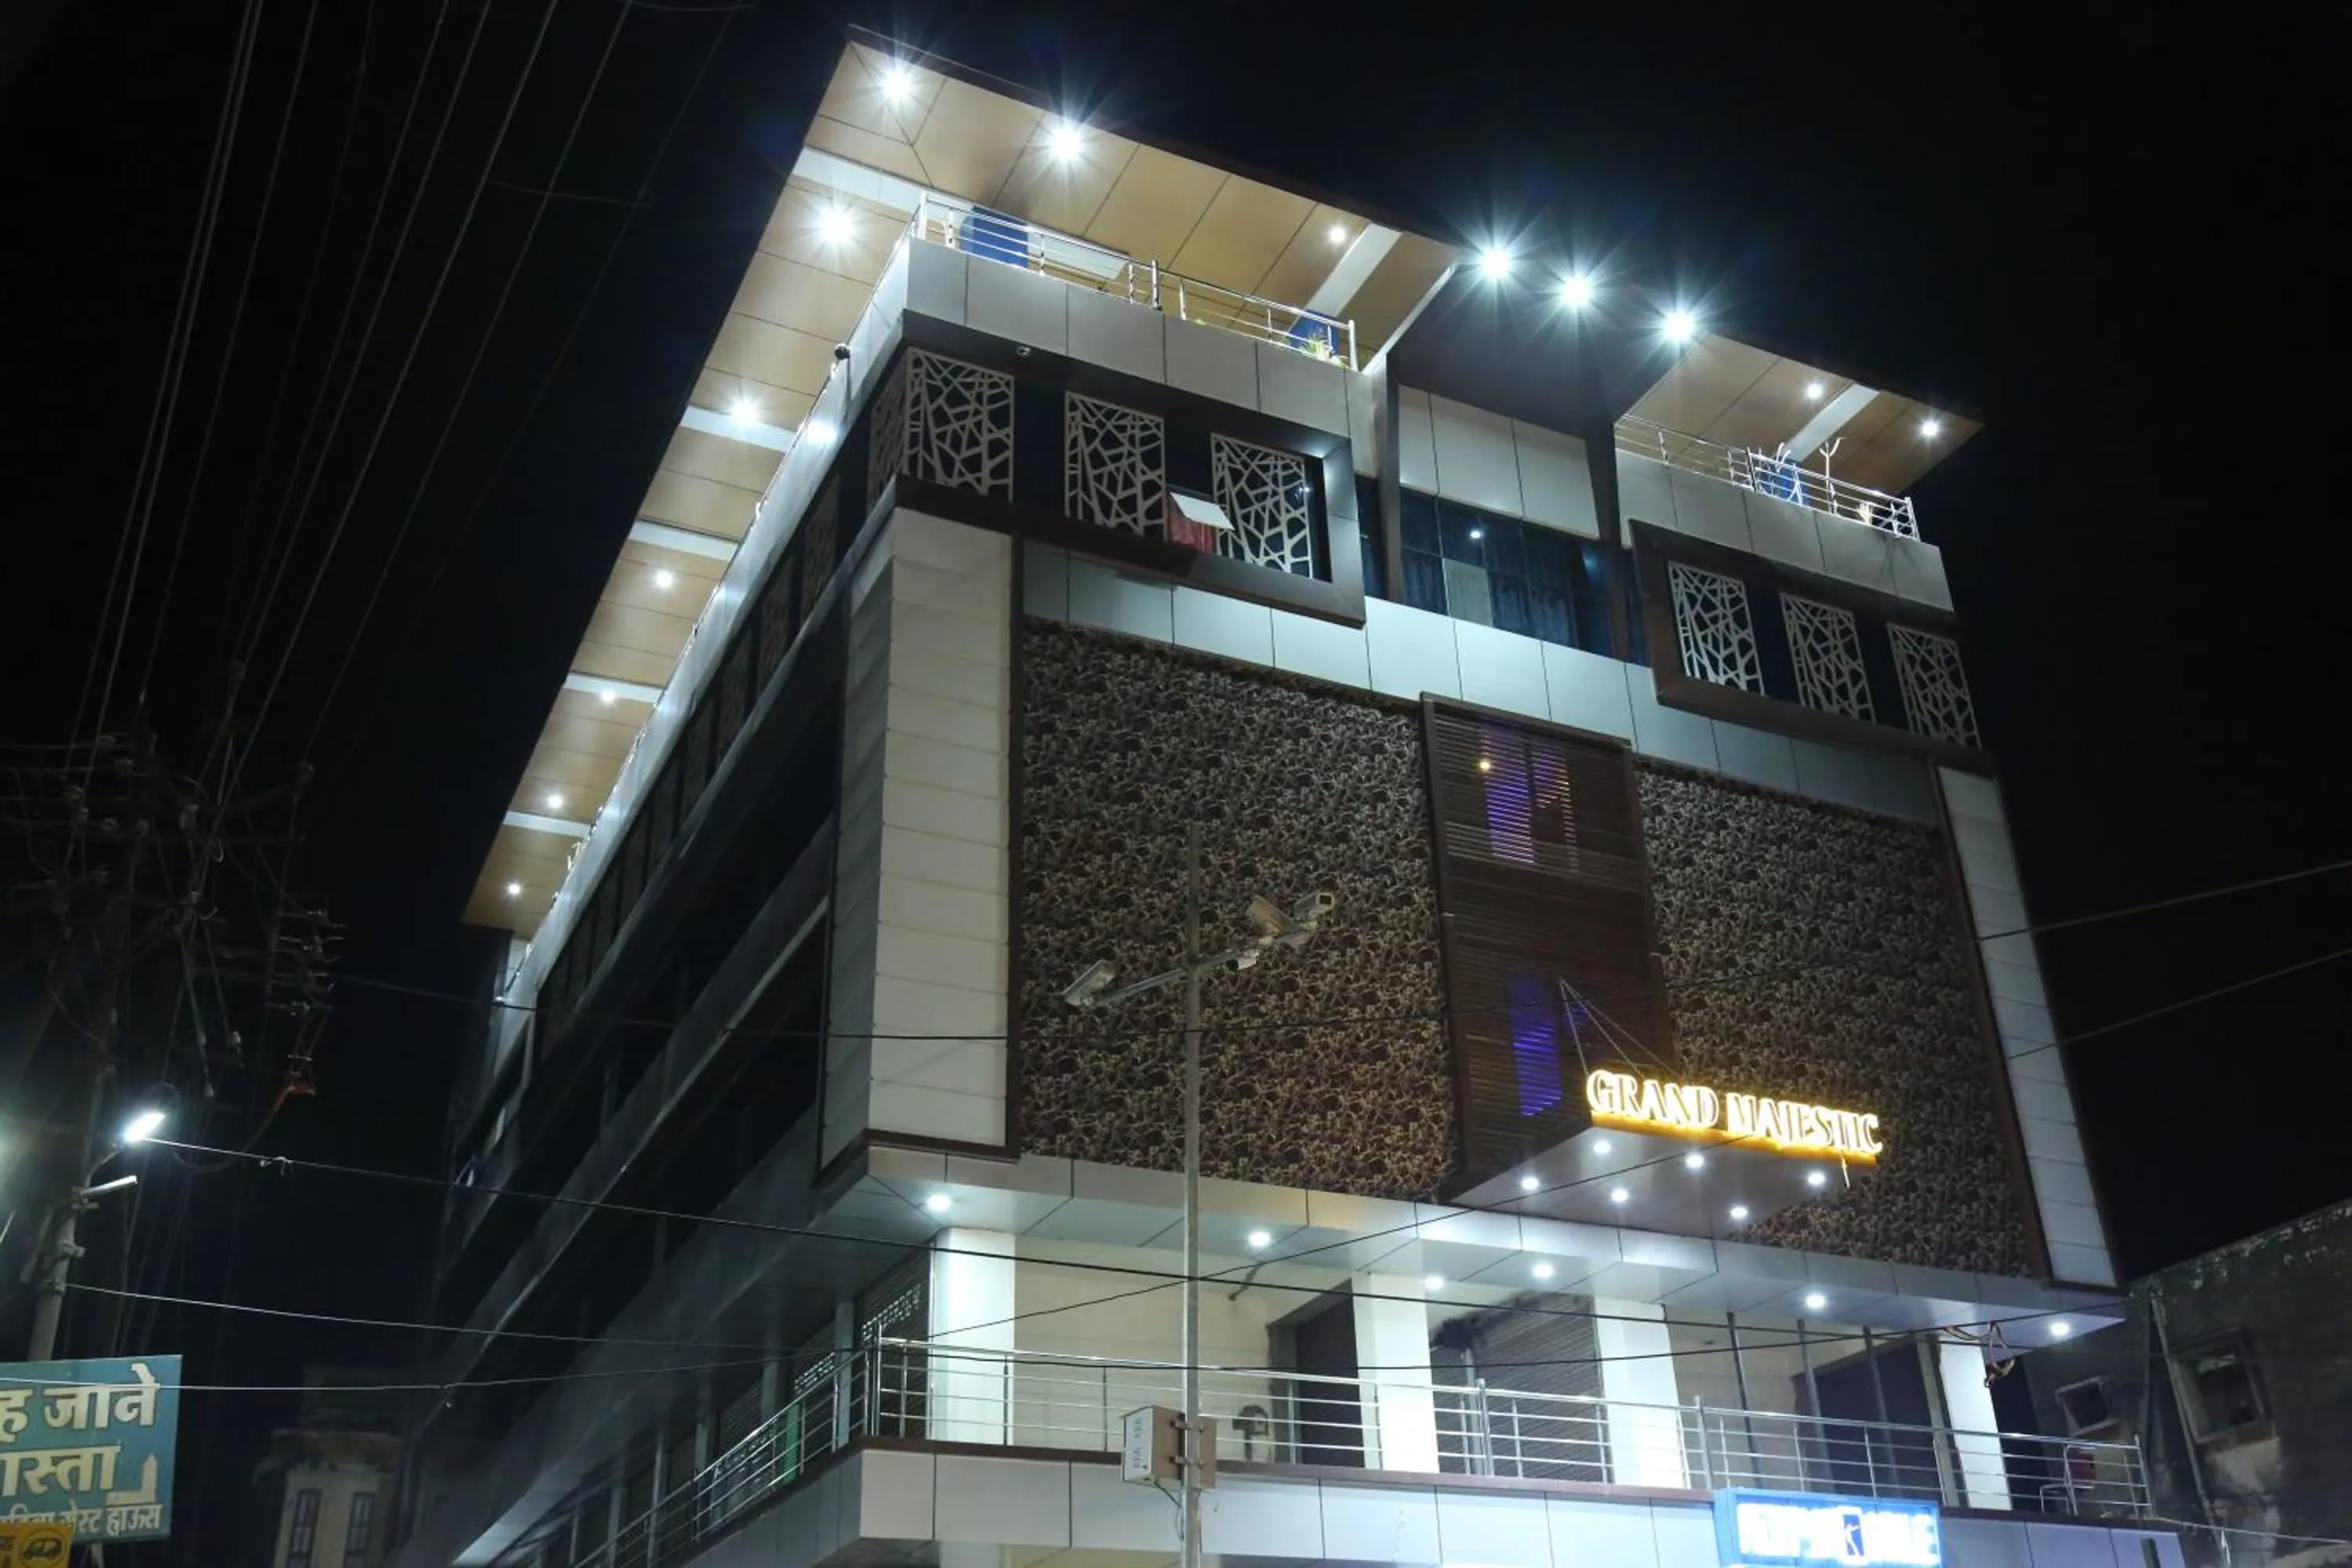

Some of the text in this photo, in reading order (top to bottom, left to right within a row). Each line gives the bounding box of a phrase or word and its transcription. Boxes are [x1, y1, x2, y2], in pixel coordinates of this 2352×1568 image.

[1587, 1069, 1882, 1154] GRAND MAJESTIC
[0, 1363, 160, 1442] ह जाने
[0, 1445, 121, 1497] ास्ता
